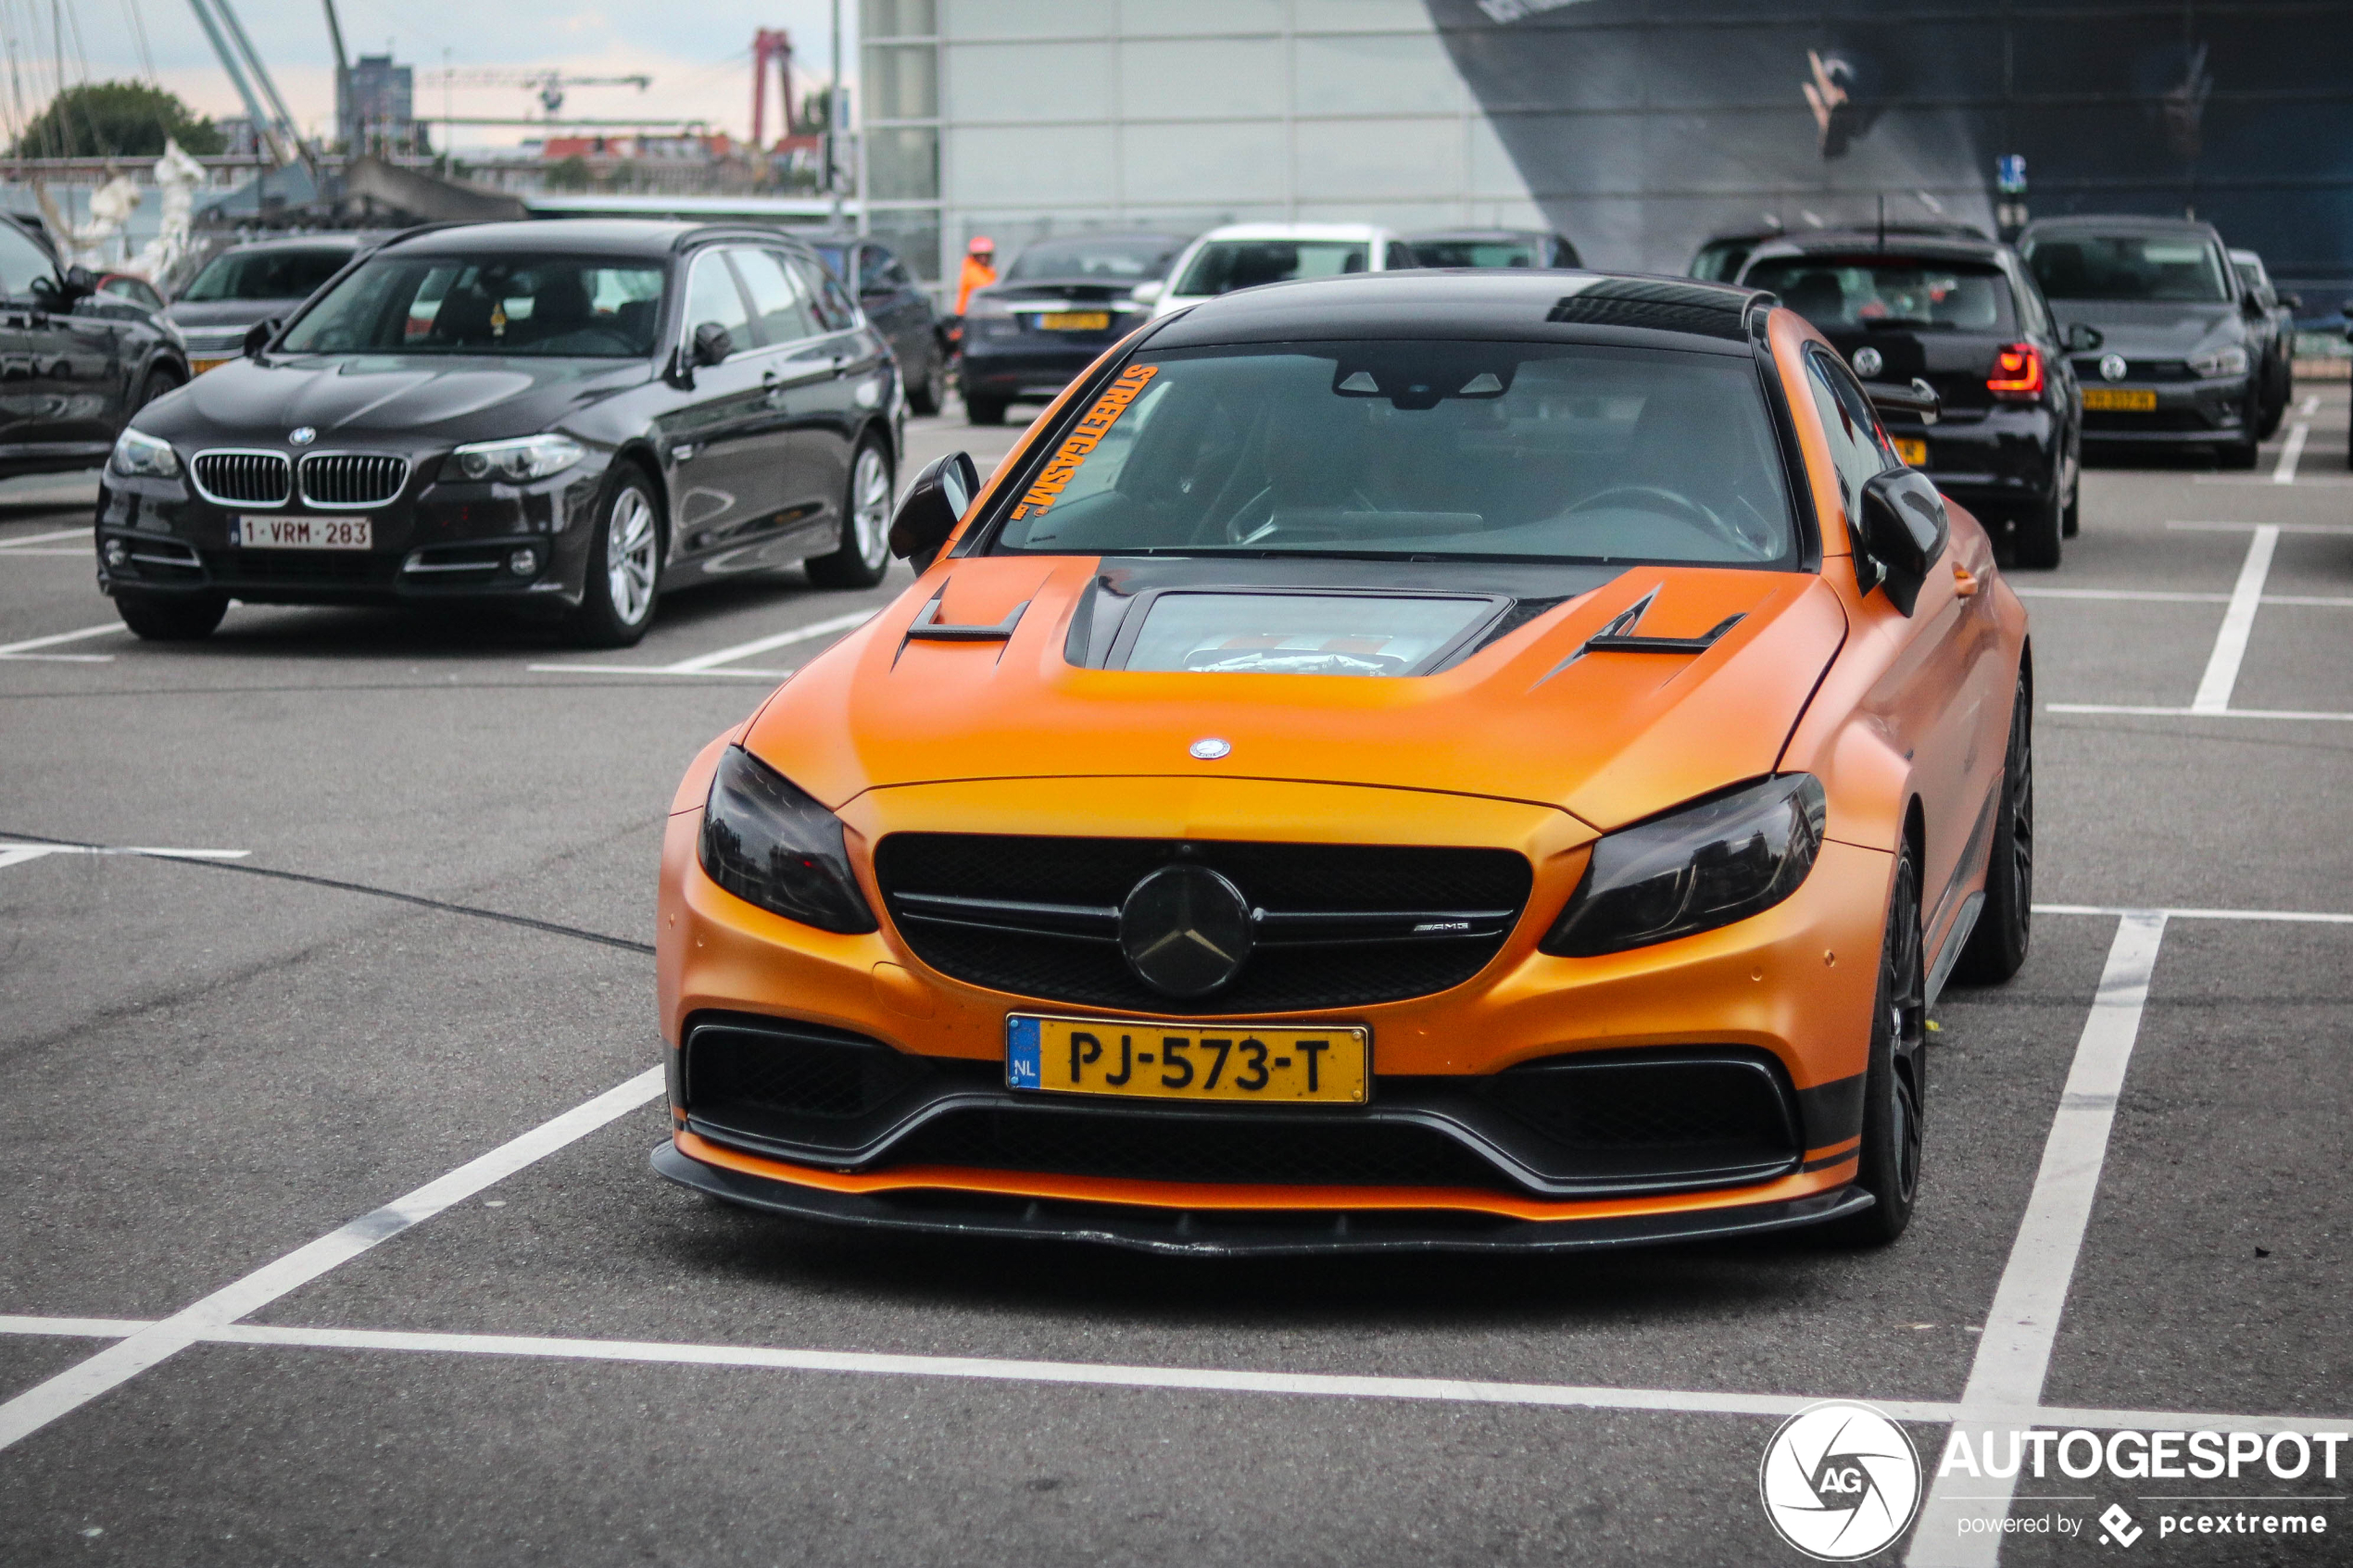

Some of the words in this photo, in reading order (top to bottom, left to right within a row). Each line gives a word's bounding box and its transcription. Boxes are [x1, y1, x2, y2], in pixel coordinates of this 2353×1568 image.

[1432, 922, 1469, 931] AMG
[1013, 1060, 1037, 1077] NL
[1070, 1031, 1329, 1092] PJ-573-T
